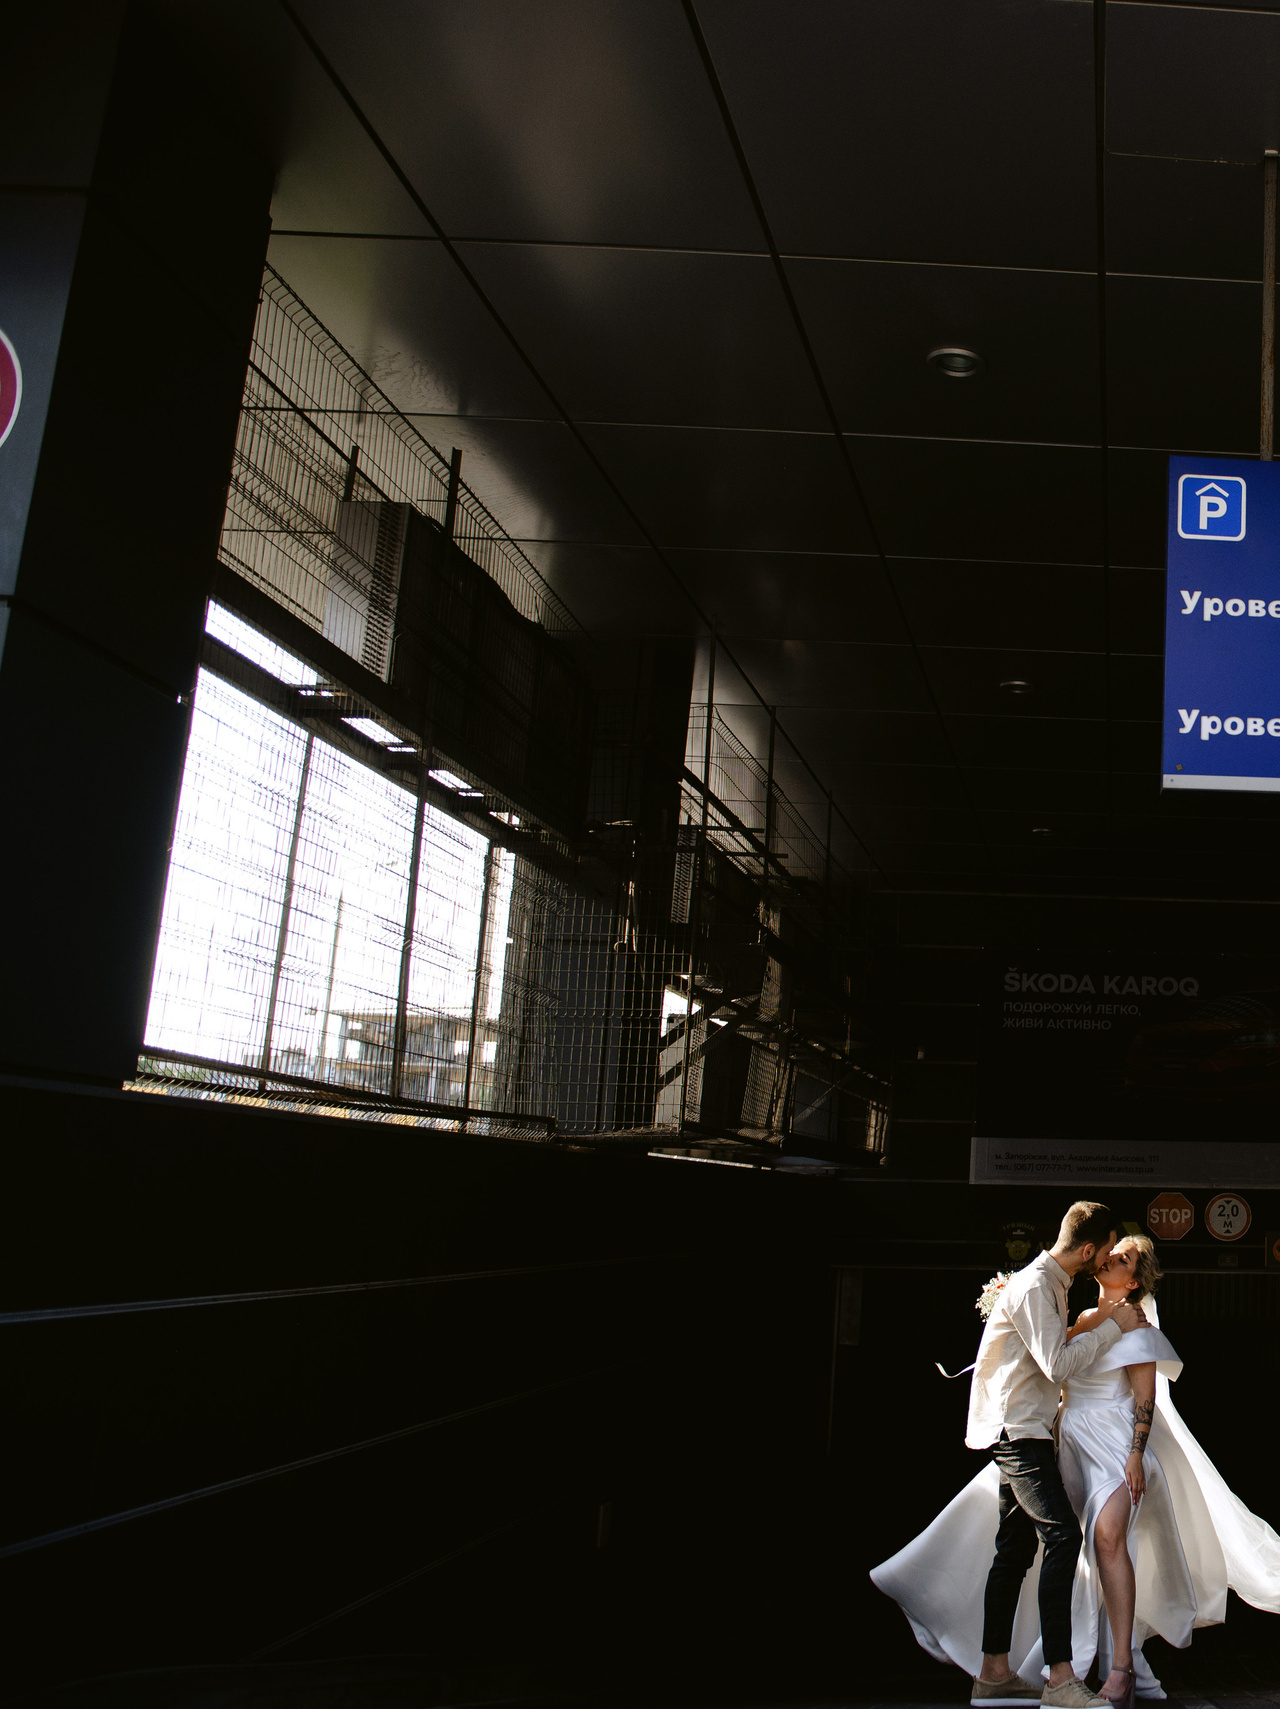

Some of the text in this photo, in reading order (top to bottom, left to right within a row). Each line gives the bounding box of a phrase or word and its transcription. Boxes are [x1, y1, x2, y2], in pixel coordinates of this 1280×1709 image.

[1003, 967, 1200, 997] ŠKODA KAROQ
[1002, 1001, 1141, 1017] ПОДОРОЖУЙ ЛЕГКО,
[1002, 1017, 1112, 1031] ЖИВИ АКТИВНО
[1013, 1162, 1034, 1172] (067)
[1150, 1208, 1192, 1224] STOP
[1217, 1204, 1239, 1219] 2,0
